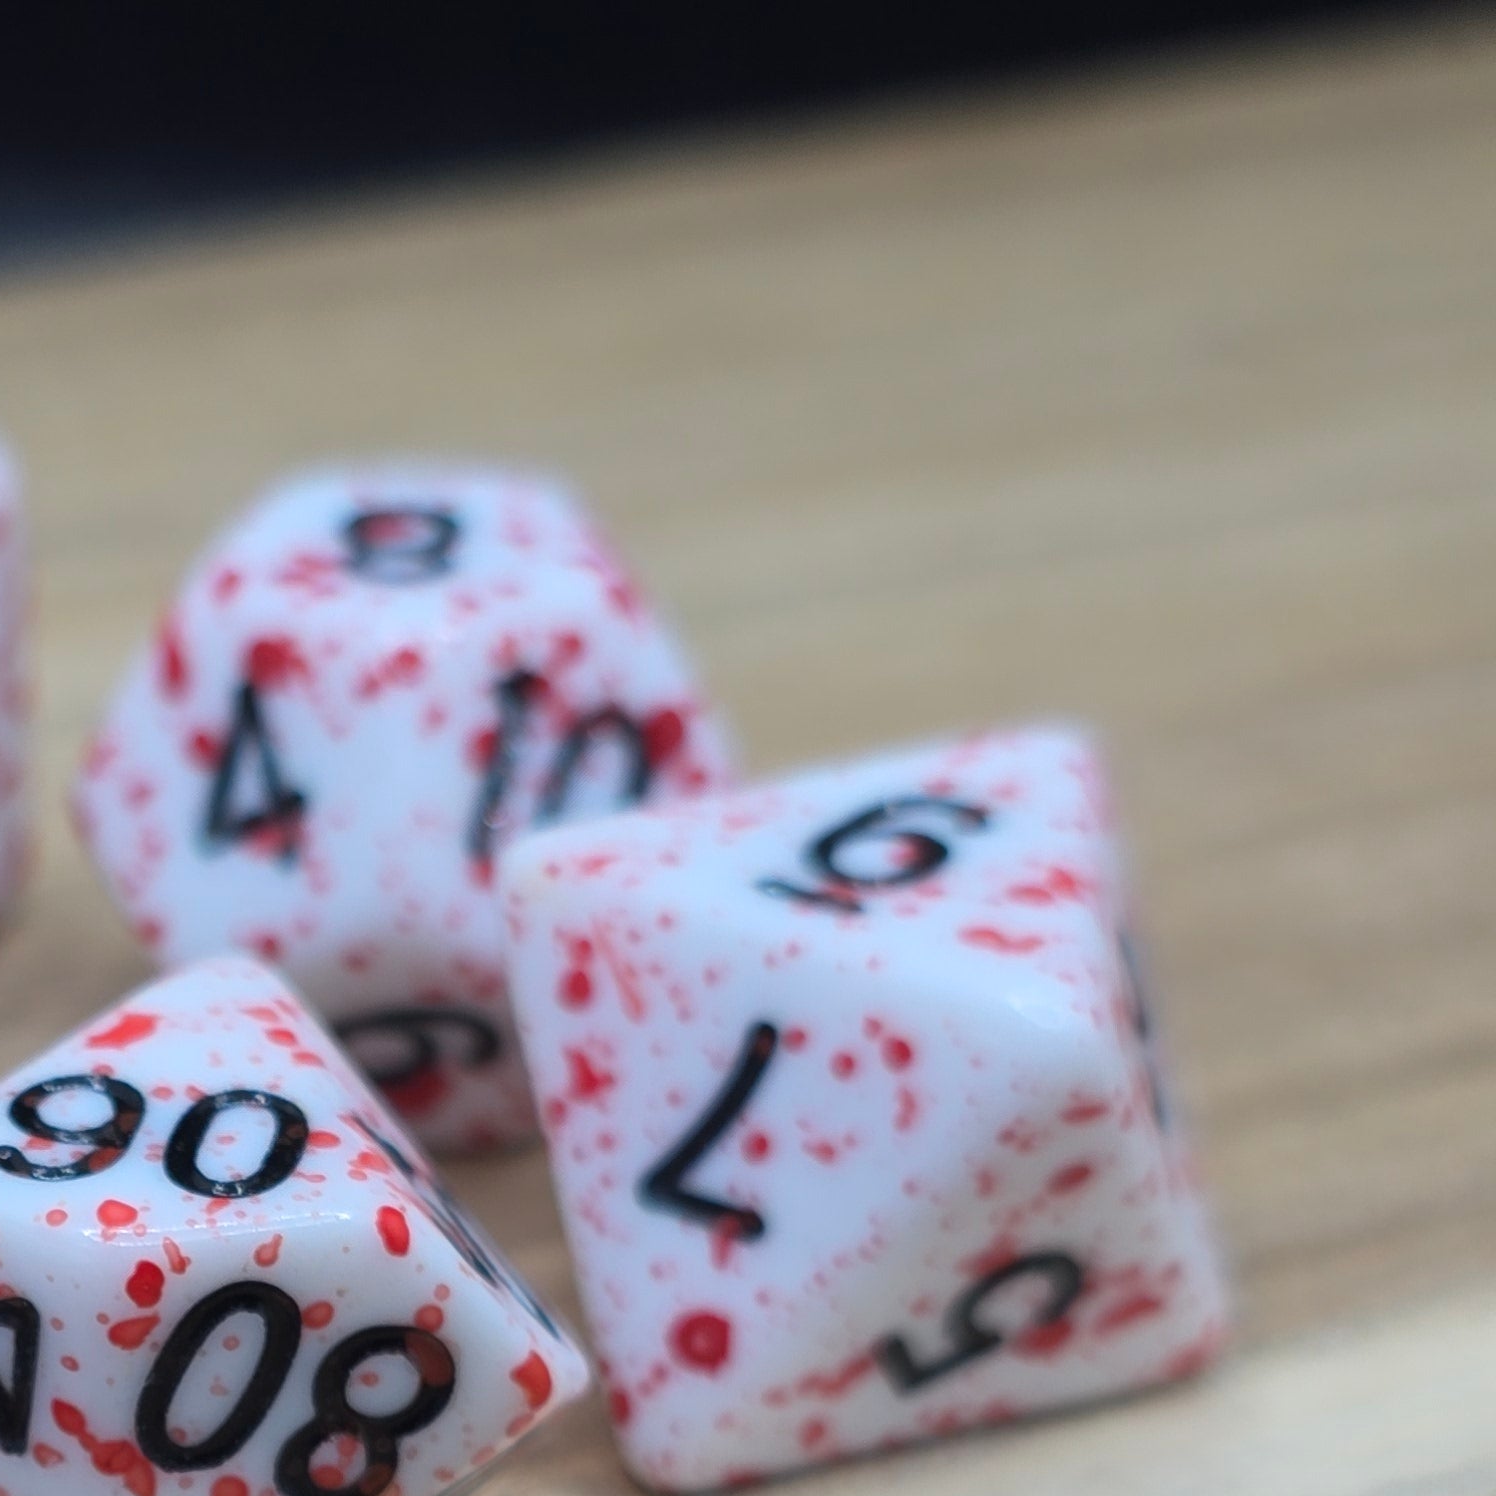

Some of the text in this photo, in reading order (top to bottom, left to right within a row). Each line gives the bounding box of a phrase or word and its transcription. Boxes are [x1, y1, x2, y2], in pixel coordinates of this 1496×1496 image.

[199, 682, 309, 865] 4
[637, 1022, 779, 1242] 7
[872, 1250, 1086, 1393] 5
